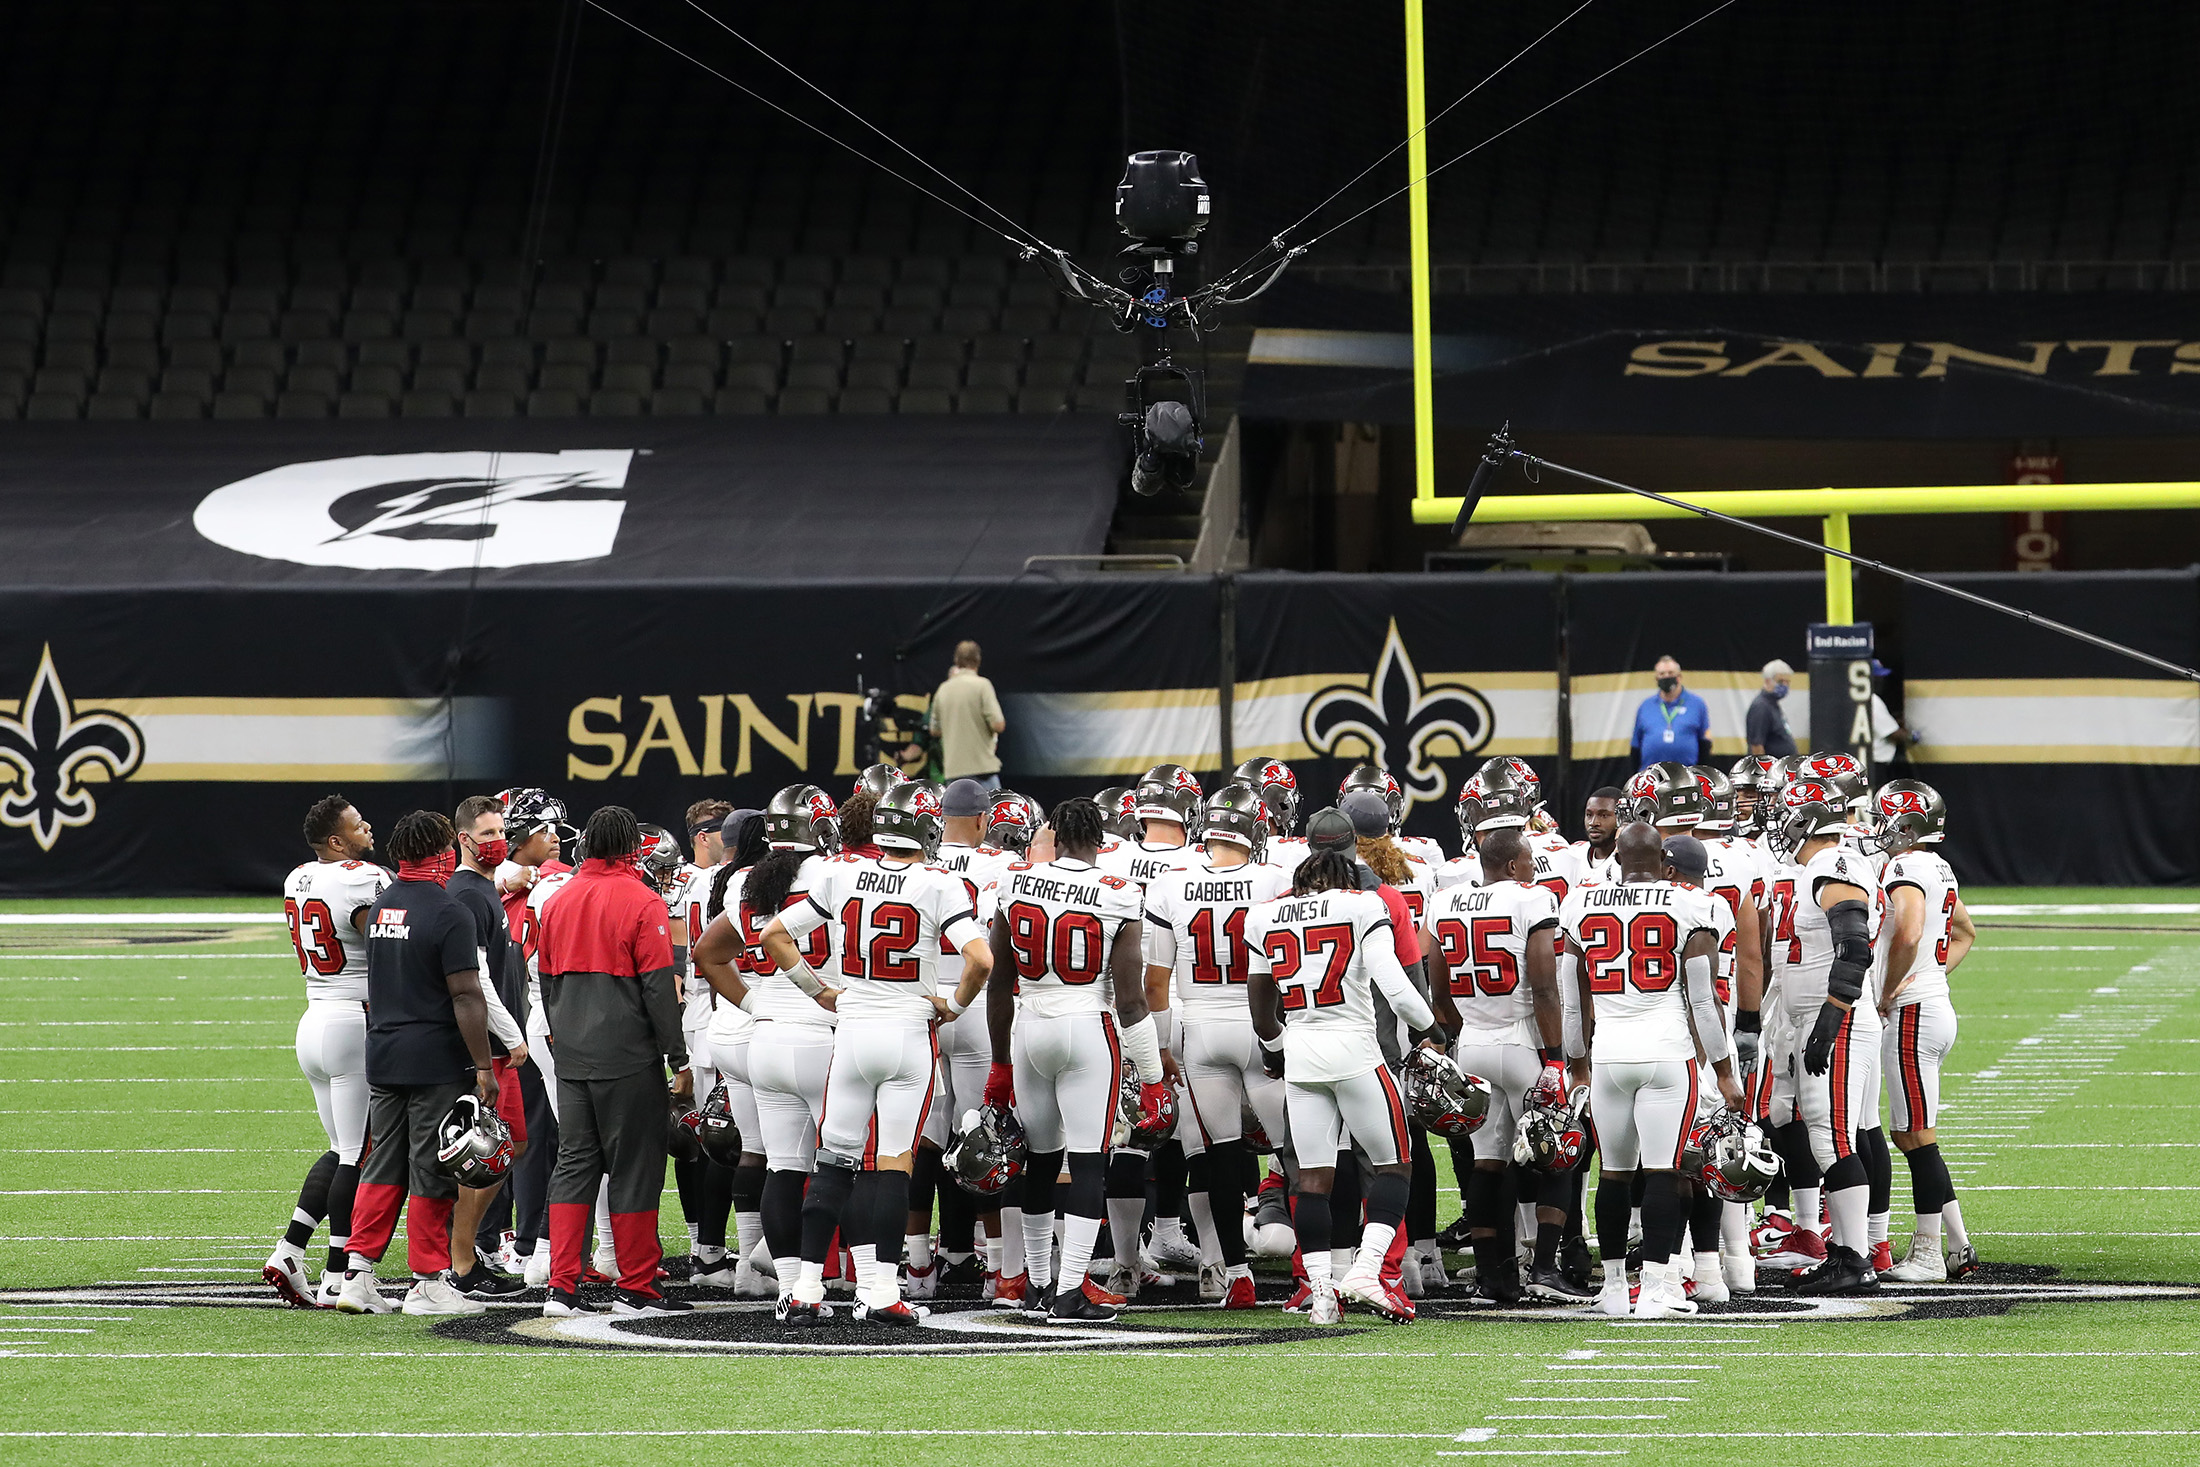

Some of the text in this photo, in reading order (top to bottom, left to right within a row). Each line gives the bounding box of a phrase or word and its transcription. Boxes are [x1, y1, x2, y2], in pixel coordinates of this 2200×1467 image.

[1624, 341, 2200, 378] SAINT
[1814, 636, 1867, 648] End Racism
[856, 871, 907, 894] BRADY
[1012, 874, 1102, 908] PIERRE-PAUL
[1184, 880, 1253, 902] GABBERT
[1584, 888, 1674, 908] FOURNETTE
[381, 909, 407, 924] END
[1272, 901, 1318, 924] JONES
[1450, 892, 1493, 912] McCOY
[284, 896, 347, 975] 93
[369, 925, 411, 939] RACISM
[841, 897, 920, 982] 12
[1008, 900, 1103, 985] 90
[1188, 907, 1249, 984] 11
[1263, 922, 1355, 1011] 27
[1436, 916, 1520, 997] 25
[1578, 912, 1678, 994] 28
